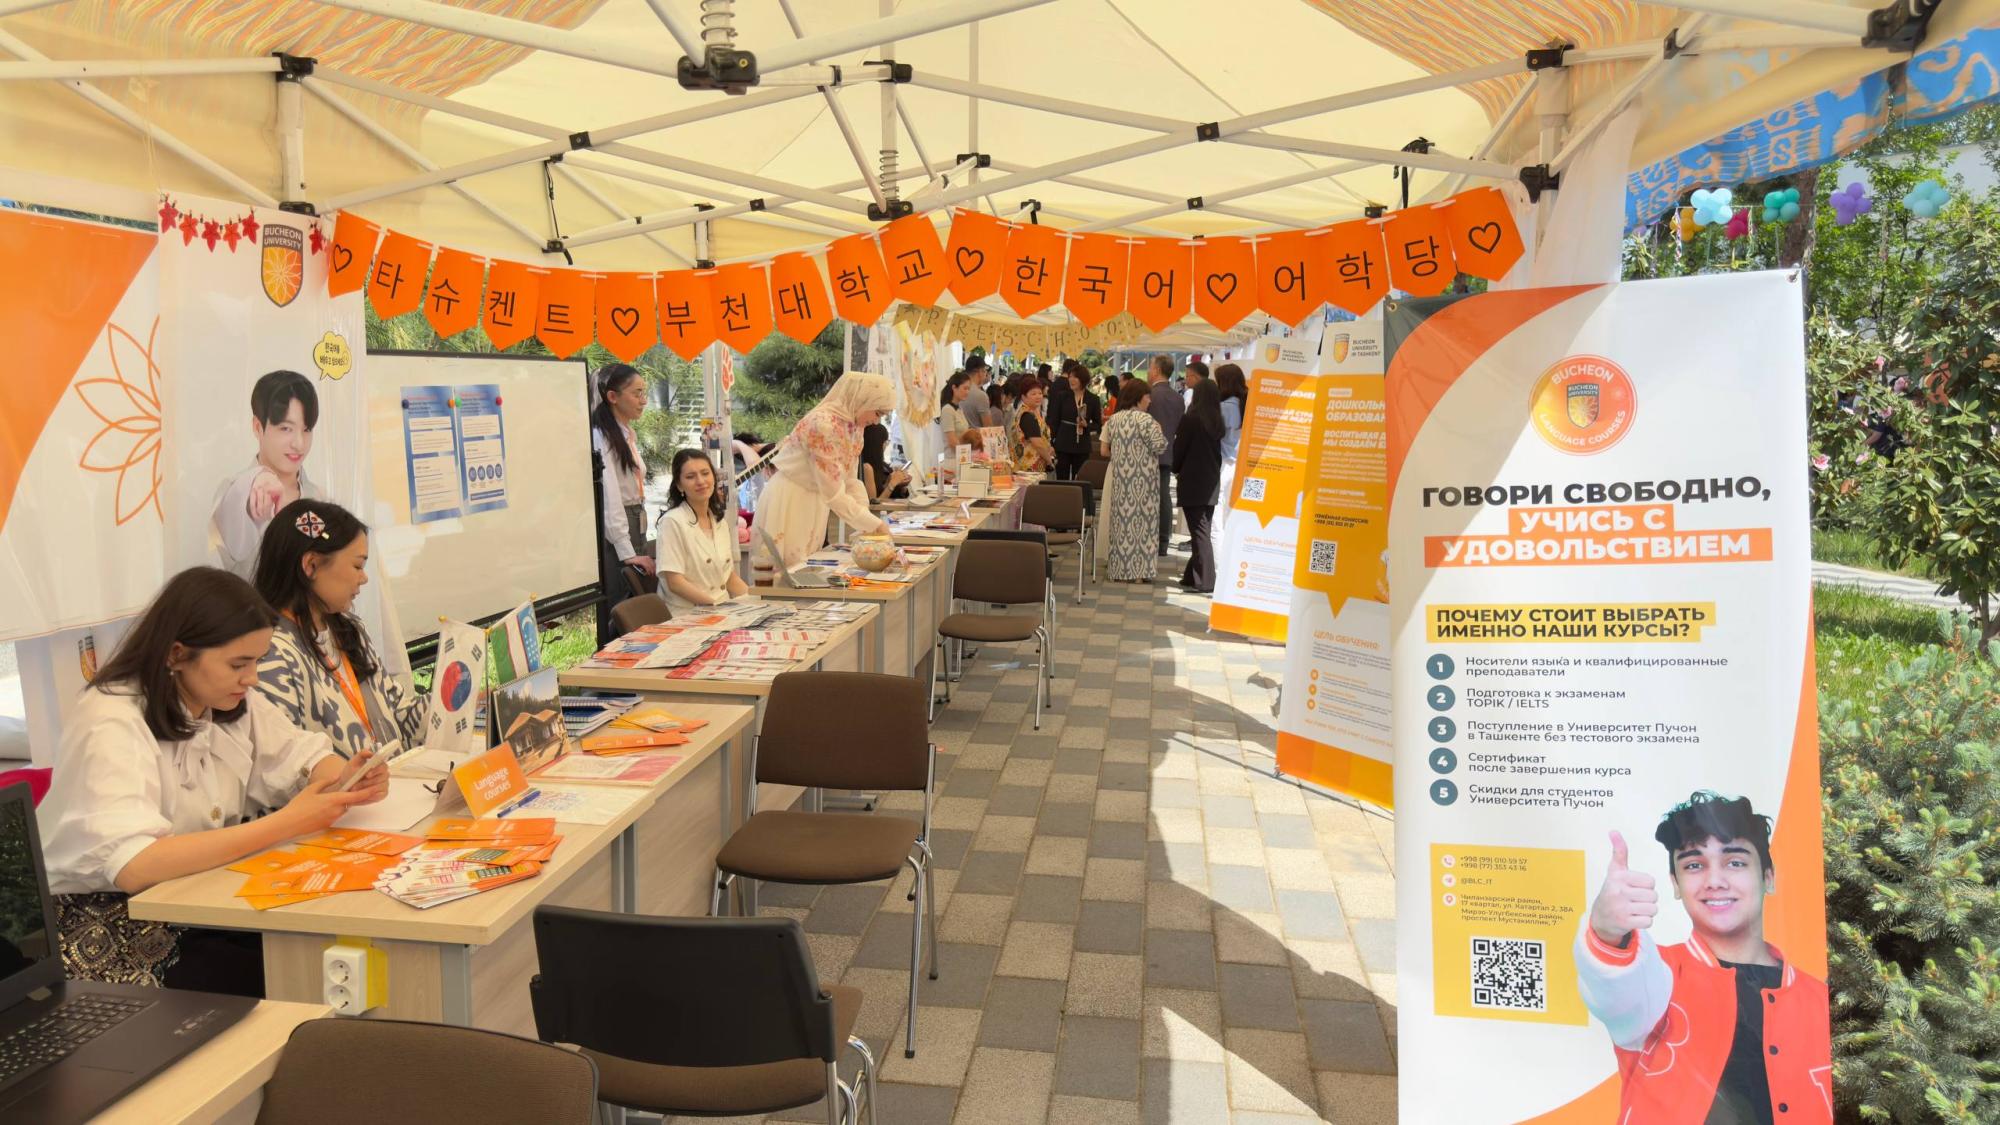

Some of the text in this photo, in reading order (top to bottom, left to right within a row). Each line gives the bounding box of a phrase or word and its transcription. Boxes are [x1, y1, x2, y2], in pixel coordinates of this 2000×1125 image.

[264, 227, 301, 240] BUCHEON
[264, 237, 301, 250] UNIVERSITY
[375, 235, 1441, 338] 타슈켄트 부천대학교 한국어 어학당
[927, 310, 1143, 348] PRESCHOOL
[1552, 364, 1614, 384] BUCHEON
[1540, 410, 1626, 446] LANGUAGE COURSES
[1423, 476, 1771, 508] ГОВОРИ СВОБОДНО,
[1520, 508, 1666, 533] УЧИСЬ С
[1442, 534, 1750, 564] УДОВОЛЬСТВИЕМ
[1437, 607, 1705, 623] ПОЧЕМУ СТОИТ ВЫБРАТЬ
[1437, 623, 1690, 638] ИМЕННО НАШИ КУРСЫ?
[1436, 661, 1444, 673] 1
[1466, 656, 1728, 668] Носители языка и квалифицированные
[1466, 667, 1565, 677] преподаватели
[1436, 693, 1446, 704] 2
[1467, 688, 1541, 700] Подготовка
[1555, 690, 1626, 699] экзаменам
[1467, 698, 1550, 710] TOPIK / IELTS
[1437, 724, 1447, 735] 3
[1468, 721, 1554, 732] Поступление
[1567, 722, 1652, 734] Университет
[1655, 723, 1697, 735] Пучон
[1478, 731, 1541, 742] Ташкенте
[1544, 731, 1567, 742] без
[1570, 734, 1634, 744] тестового
[1637, 735, 1700, 744] экзамена
[1437, 756, 1448, 767] 4
[1468, 752, 1546, 765] Сертификат
[1468, 764, 1631, 777] после завершения курса
[473, 767, 509, 790] Language
[484, 780, 512, 800] courses
[1439, 787, 1449, 798] 5
[1469, 784, 1614, 799] Скидки для студентов
[1469, 795, 1604, 809] Университета Пучон
